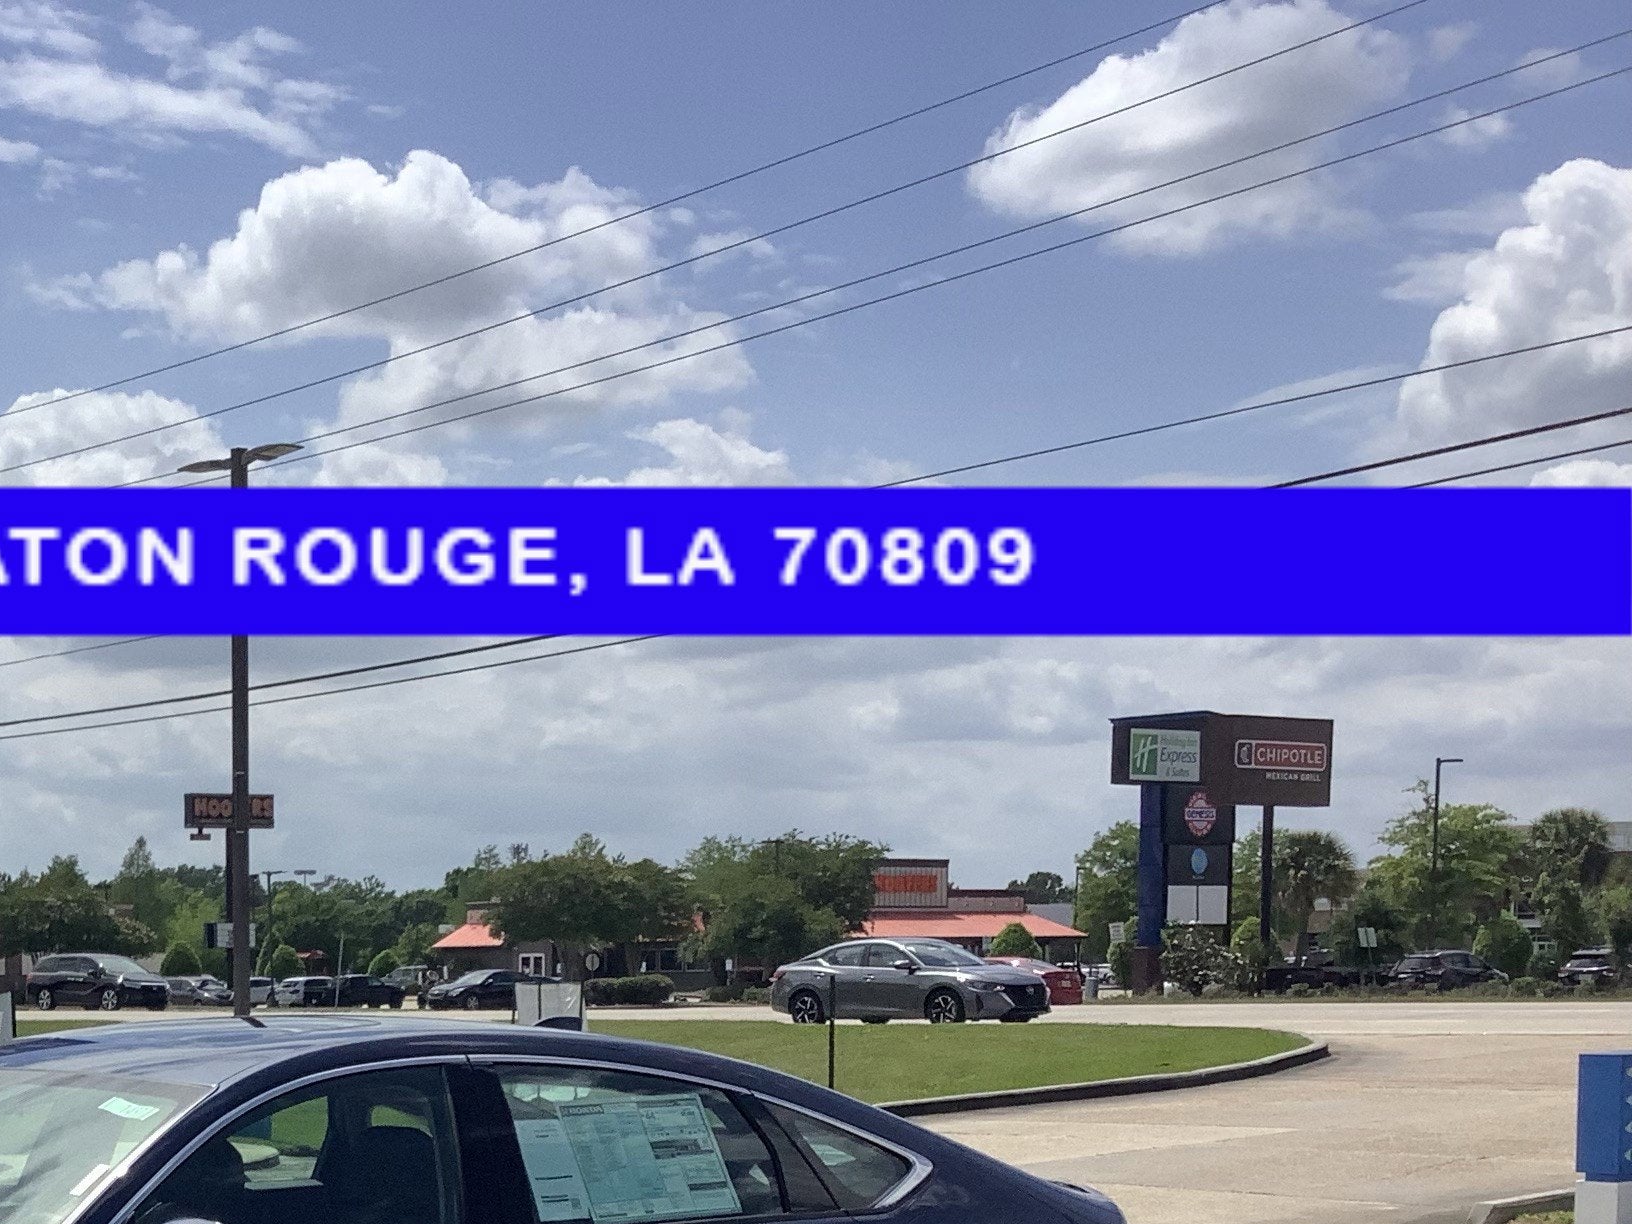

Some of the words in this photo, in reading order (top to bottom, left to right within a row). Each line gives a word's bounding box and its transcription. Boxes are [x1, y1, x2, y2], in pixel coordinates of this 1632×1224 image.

[1160, 747, 1197, 765] Express
[1257, 748, 1323, 764] CHIPOTLE
[1266, 772, 1298, 781] MEXICAN
[1300, 774, 1321, 782] GRILL
[194, 797, 273, 818] HOORS
